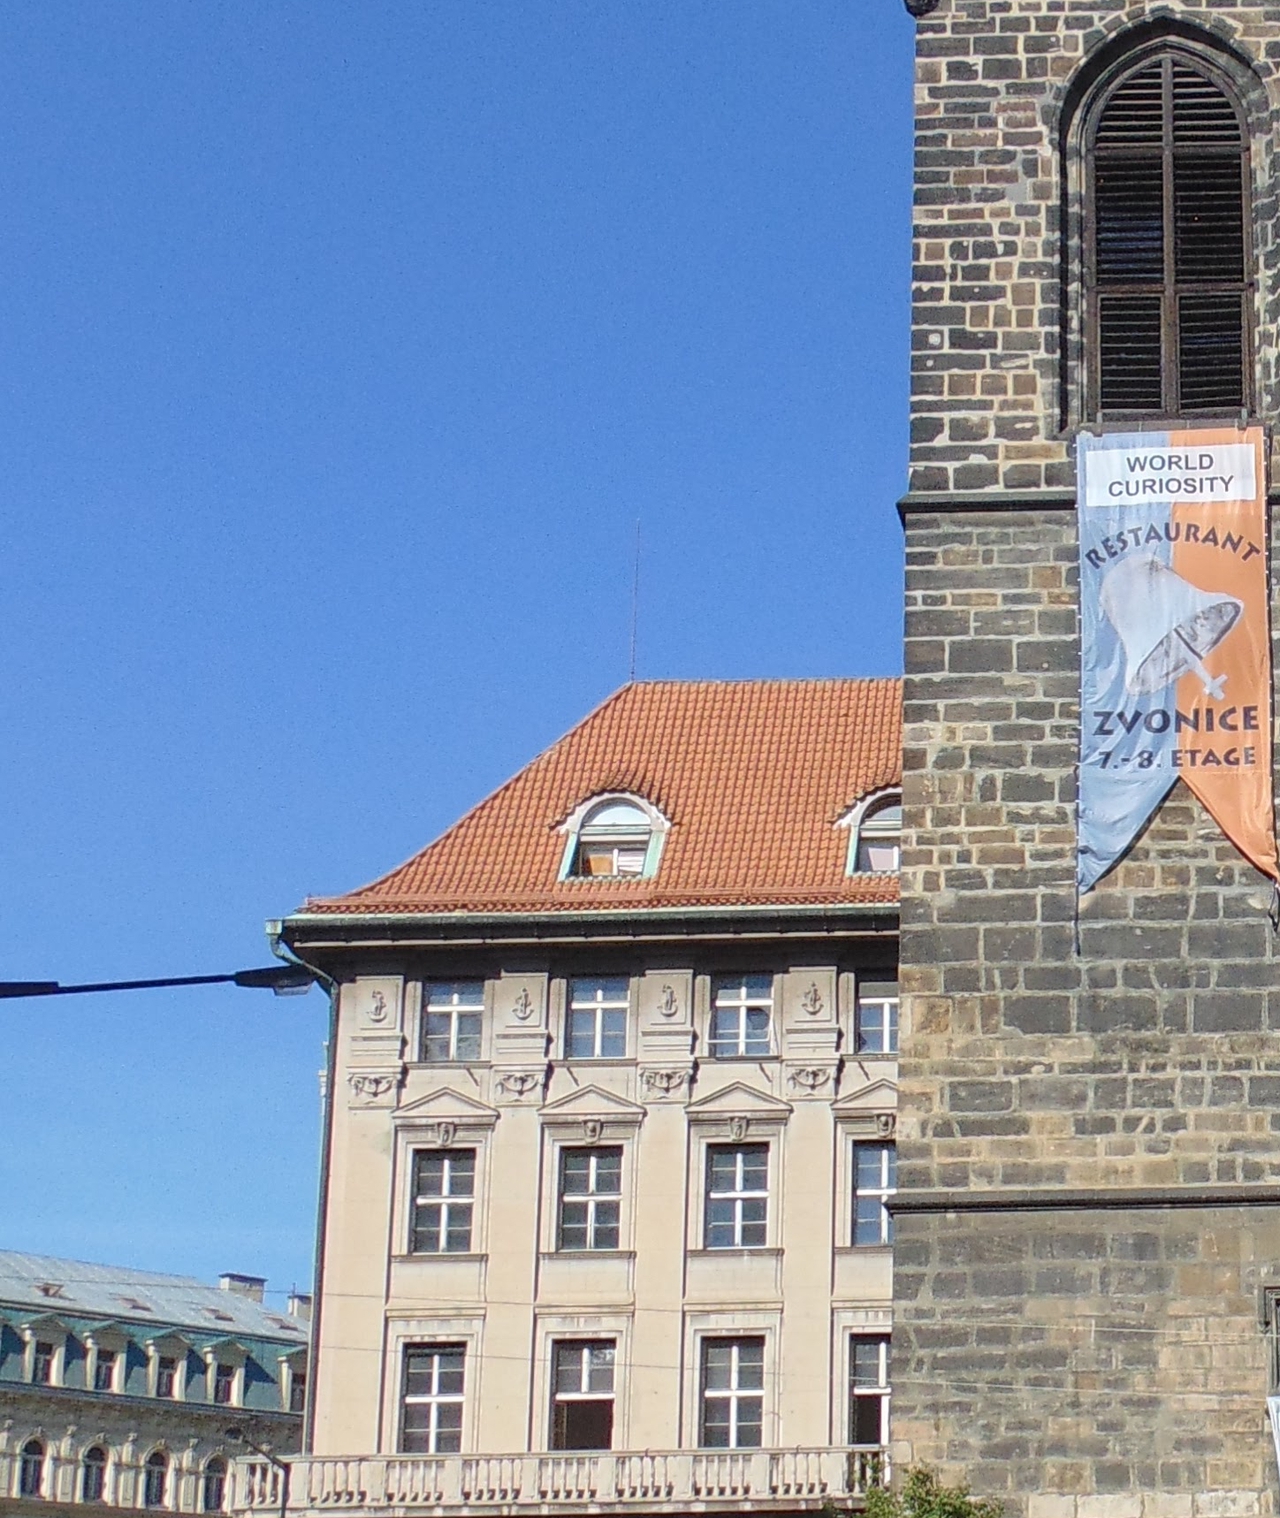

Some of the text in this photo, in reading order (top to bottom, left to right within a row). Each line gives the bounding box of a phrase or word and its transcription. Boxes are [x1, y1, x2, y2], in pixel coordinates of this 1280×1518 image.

[1126, 454, 1214, 472] WORLD
[1108, 475, 1234, 497] CURIOSITY
[1085, 522, 1260, 570] RESTAURANT
[1092, 705, 1260, 736] ZVONICE
[1171, 747, 1256, 767] ETAGE
